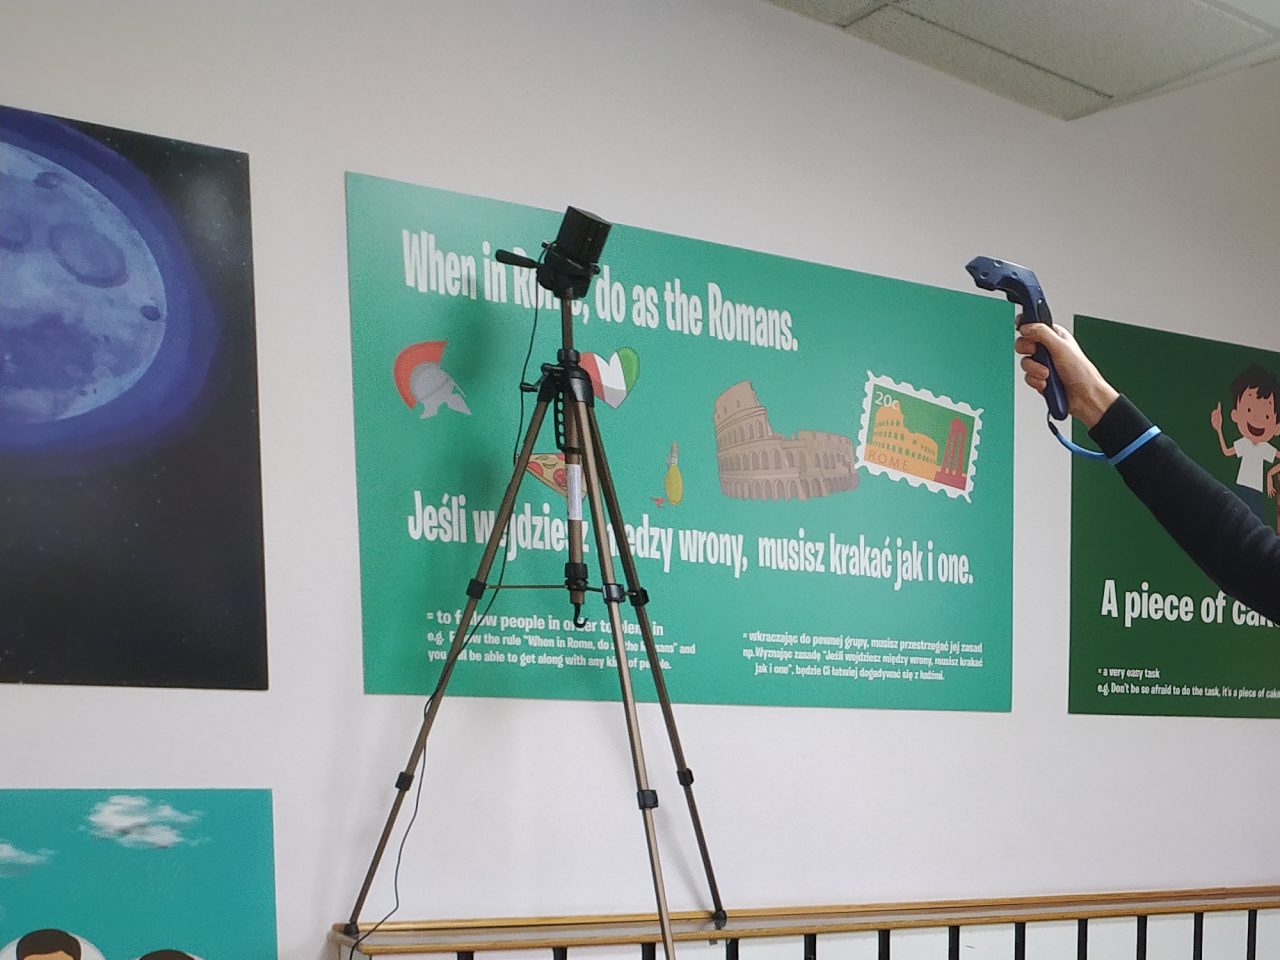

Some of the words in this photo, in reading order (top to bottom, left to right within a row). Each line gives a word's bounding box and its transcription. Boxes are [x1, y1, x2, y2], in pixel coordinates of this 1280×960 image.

[402, 229, 477, 300] When
[482, 240, 507, 304] in
[595, 264, 626, 323] do
[632, 284, 660, 329] as
[664, 278, 703, 336] the
[708, 282, 798, 351] Romans.
[868, 449, 909, 471] ROME
[408, 490, 467, 543] Jeśli
[678, 529, 748, 579] wrony,
[758, 527, 825, 572] musisz
[830, 533, 892, 578] krakać
[894, 537, 923, 591] jak
[927, 540, 934, 581] i
[938, 553, 974, 584] one.
[1101, 579, 1119, 618] A
[1124, 581, 1194, 628] piece
[1200, 589, 1227, 624] of
[437, 610, 451, 624] to
[501, 614, 545, 632] people
[548, 614, 560, 630] in
[653, 621, 664, 636] in
[484, 633, 500, 646] the
[502, 634, 522, 646] rule
[557, 636, 566, 648] in
[567, 637, 596, 650] Rome,
[597, 639, 609, 650] do
[680, 644, 696, 655] and
[800, 633, 810, 644] do
[871, 637, 898, 648] musisz
[949, 640, 960, 654] jej
[961, 642, 983, 653] zasad
[428, 650, 447, 662] you
[469, 650, 482, 661] be
[484, 651, 505, 662] able
[507, 652, 517, 663] to
[520, 653, 536, 667] get
[538, 654, 564, 669] along
[565, 654, 587, 666] with
[588, 657, 604, 669] any
[754, 662, 768, 676] jak
[914, 671, 919, 679] z
[1103, 668, 1108, 676] a
[1109, 668, 1126, 680] very
[1126, 669, 1144, 681] easy
[1144, 668, 1160, 678] task
[1130, 683, 1140, 694] be
[1141, 685, 1150, 694] so
[1151, 684, 1171, 695] afraid
[1173, 685, 1180, 695] to
[1182, 685, 1190, 695] do
[1192, 686, 1203, 696] the
[1233, 689, 1238, 697] a
[1238, 687, 1257, 700] piece
[1257, 687, 1266, 698] of
